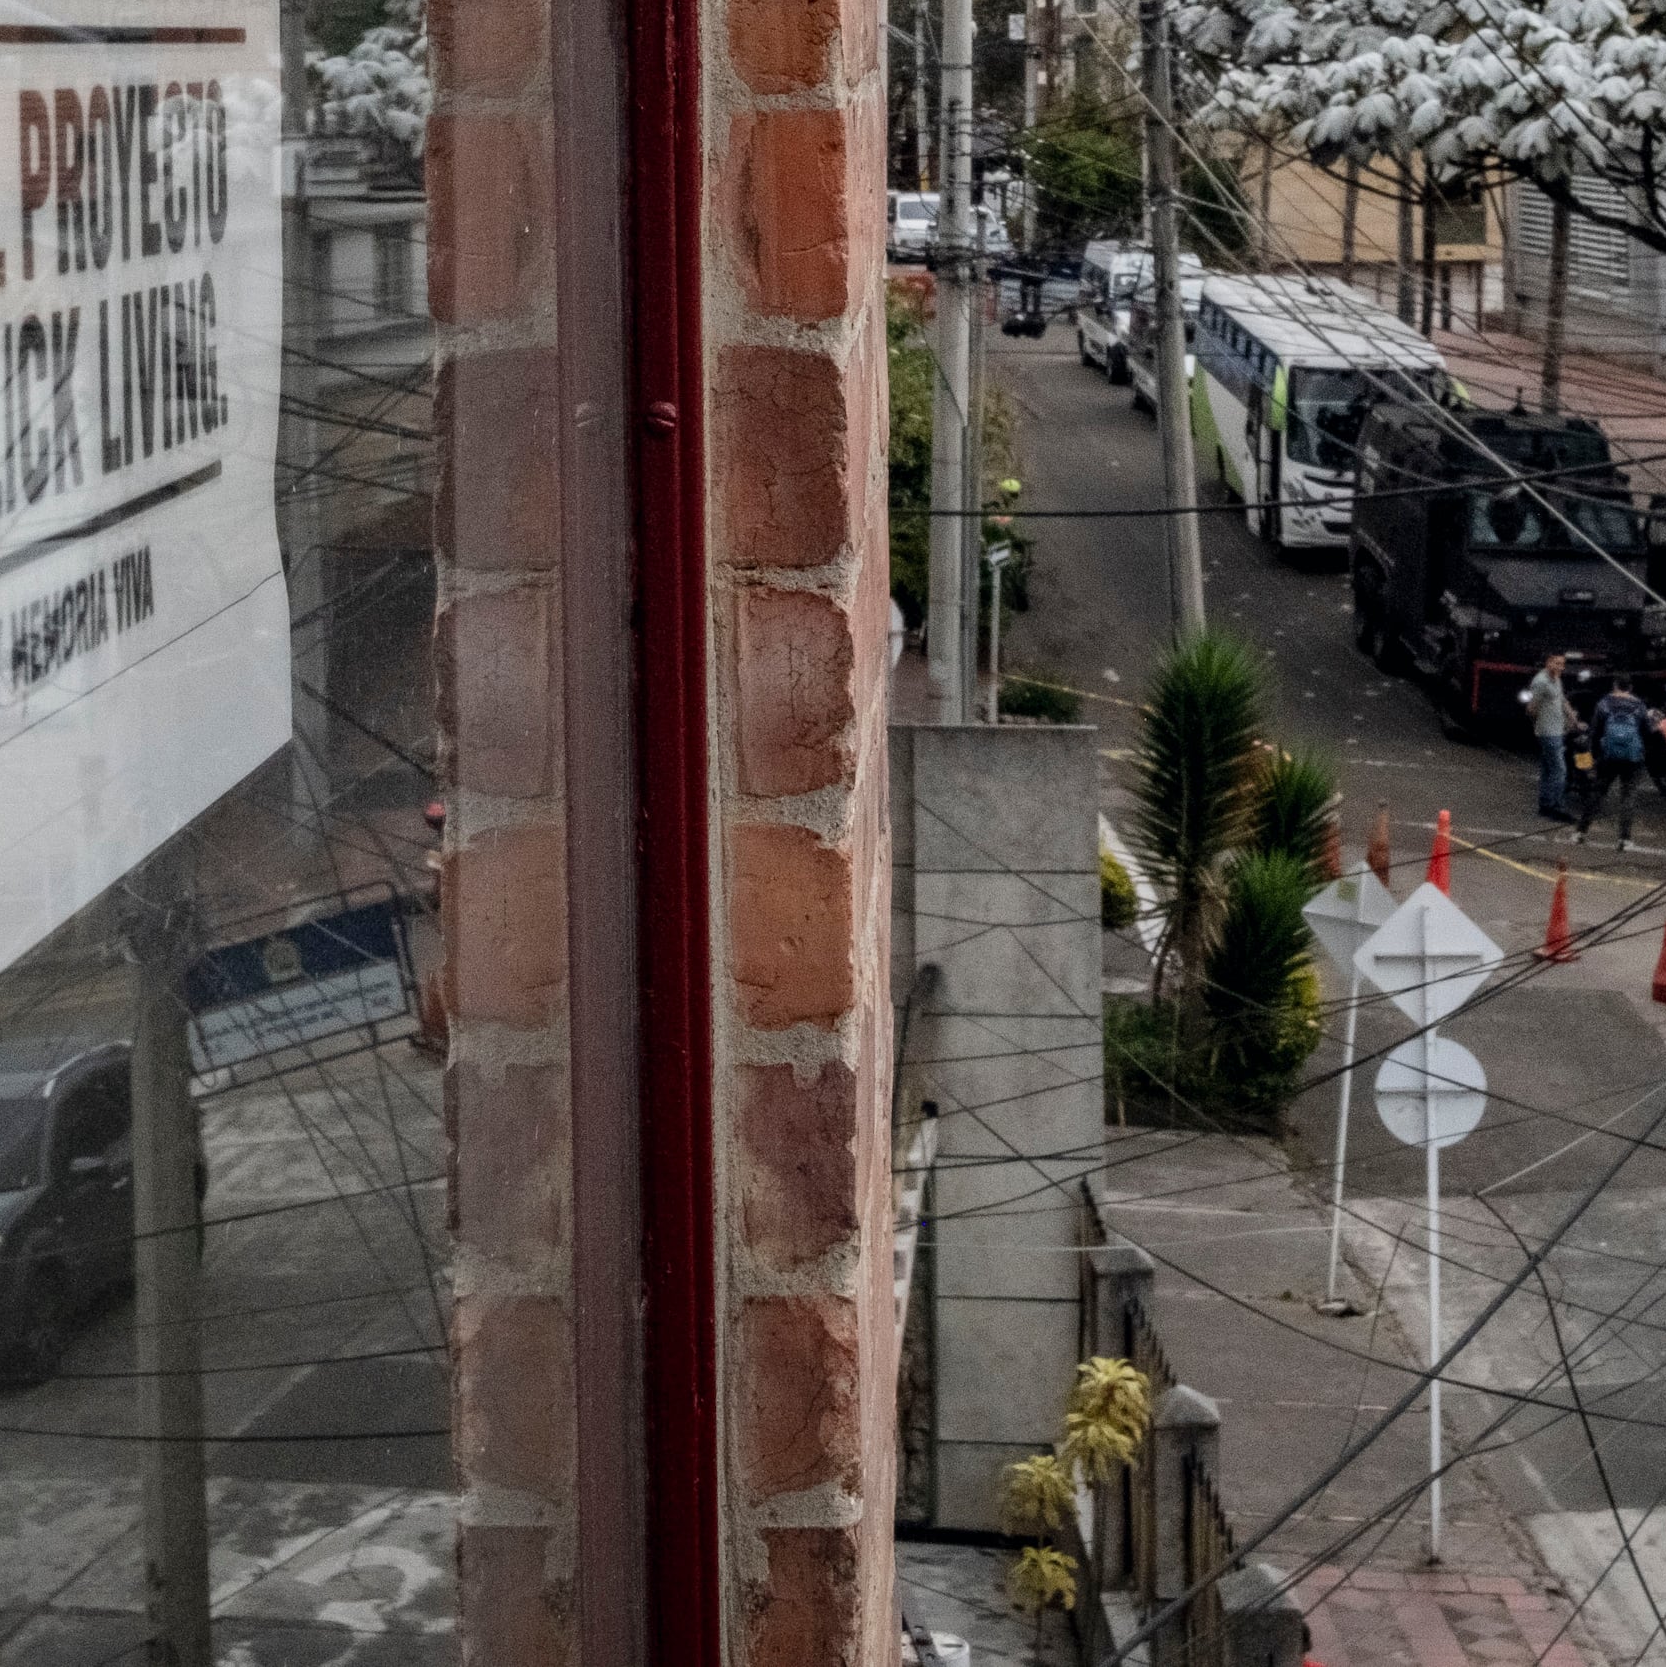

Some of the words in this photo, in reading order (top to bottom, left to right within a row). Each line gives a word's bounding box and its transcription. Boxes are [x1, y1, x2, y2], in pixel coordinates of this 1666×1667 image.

[19, 80, 229, 282] PROYECTO
[98, 271, 228, 476] LIVING.
[9, 567, 109, 694] MEMORIA
[113, 544, 155, 635] VIVA
